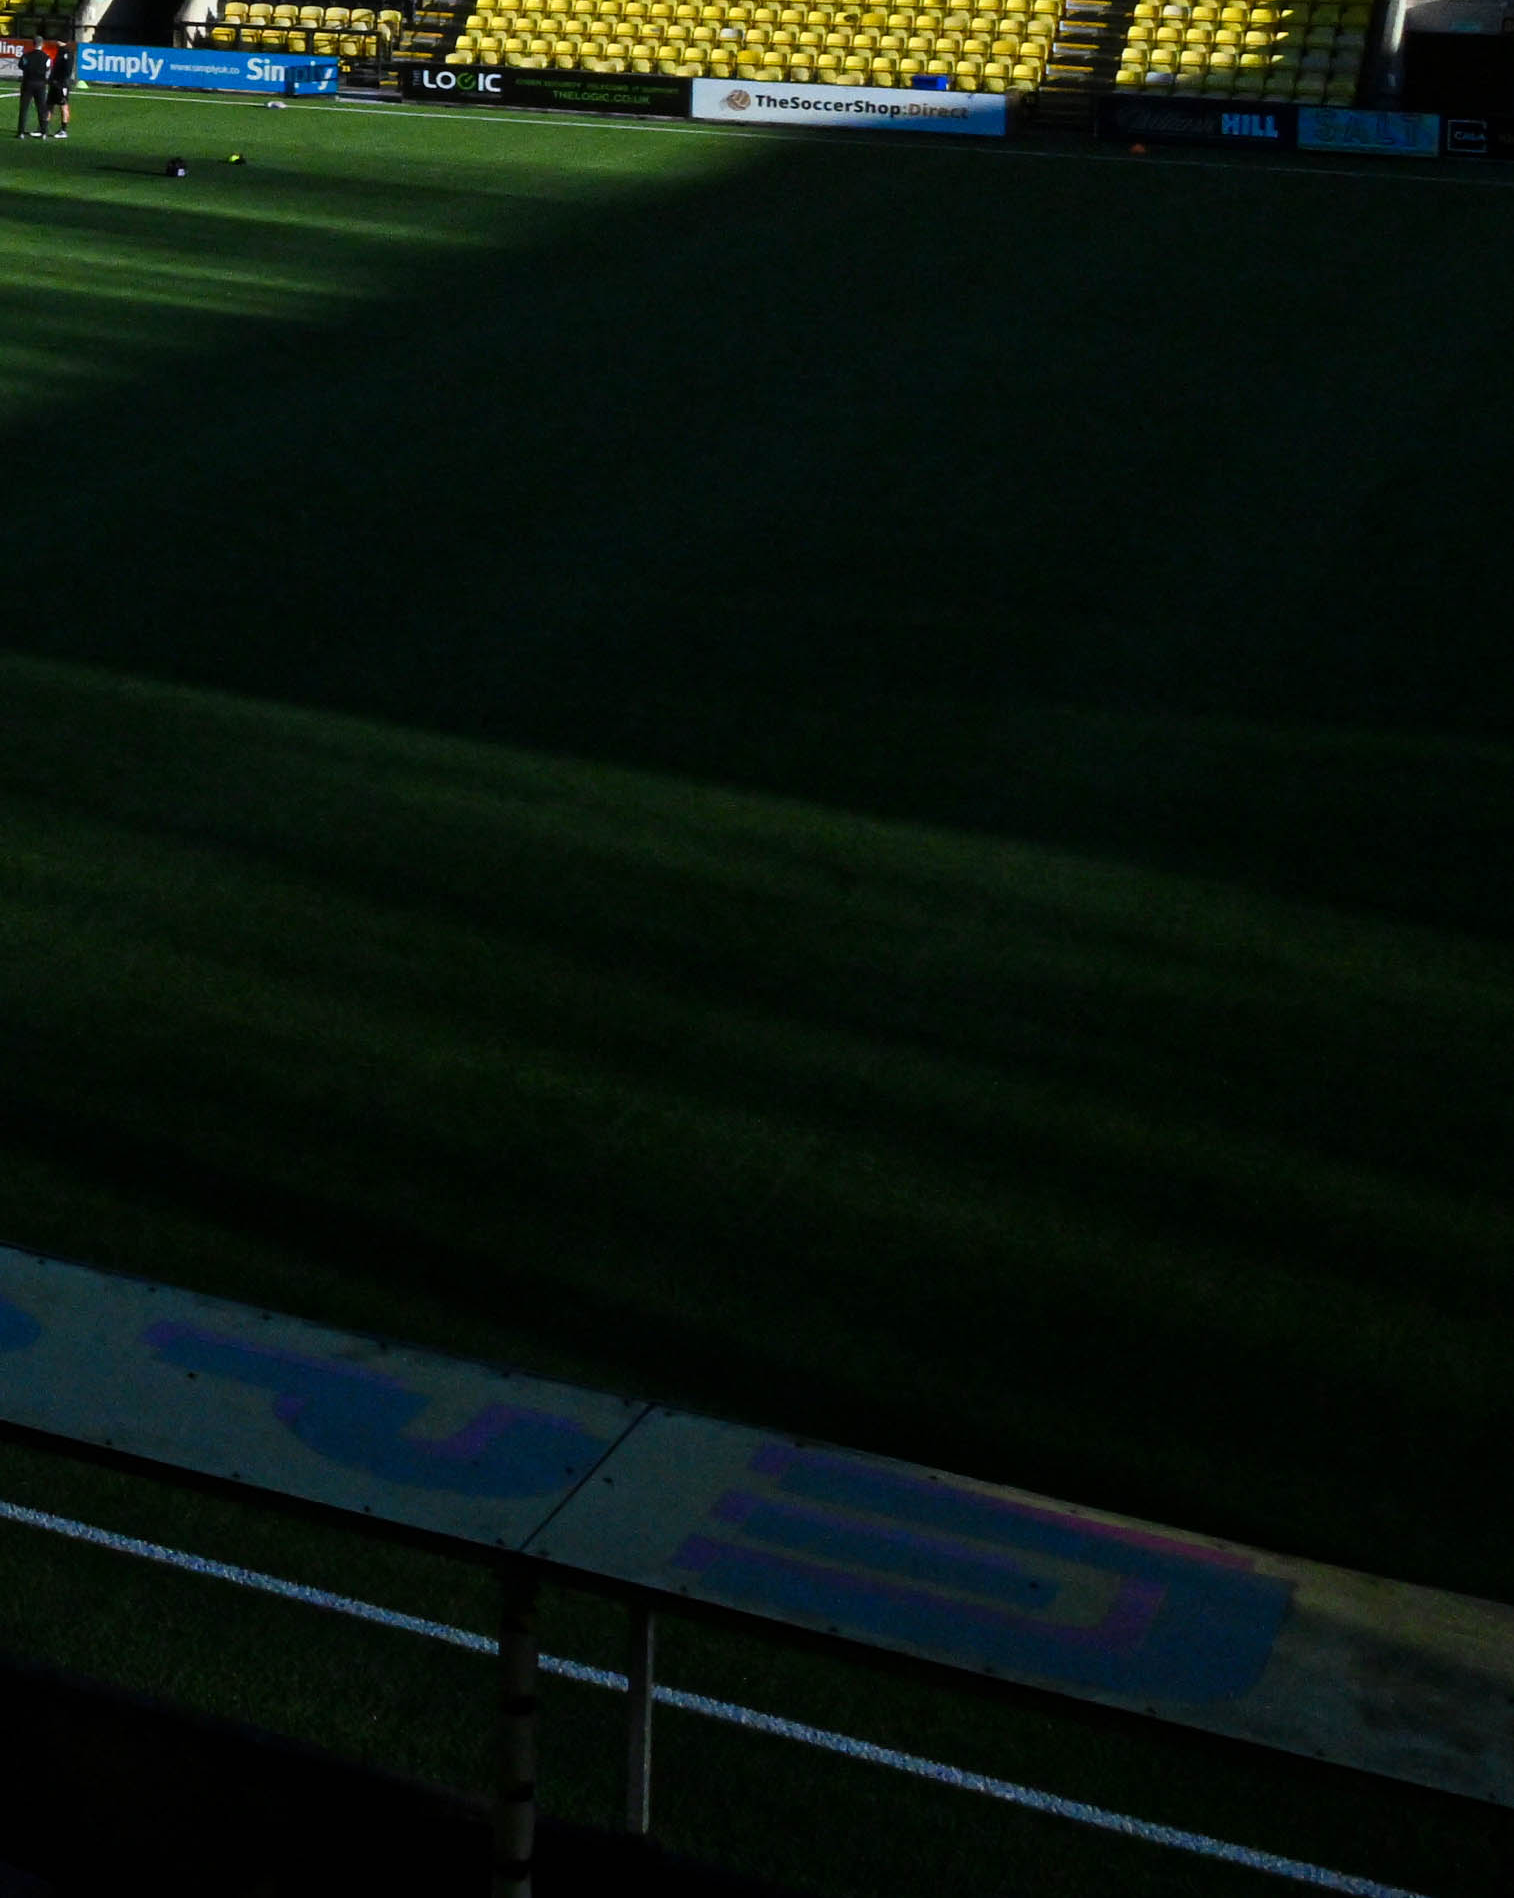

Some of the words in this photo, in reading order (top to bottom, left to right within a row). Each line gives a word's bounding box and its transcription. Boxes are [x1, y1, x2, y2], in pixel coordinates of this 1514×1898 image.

[81, 47, 164, 80] Simply
[422, 68, 502, 93] LOGIC
[1221, 112, 1279, 138] HILL
